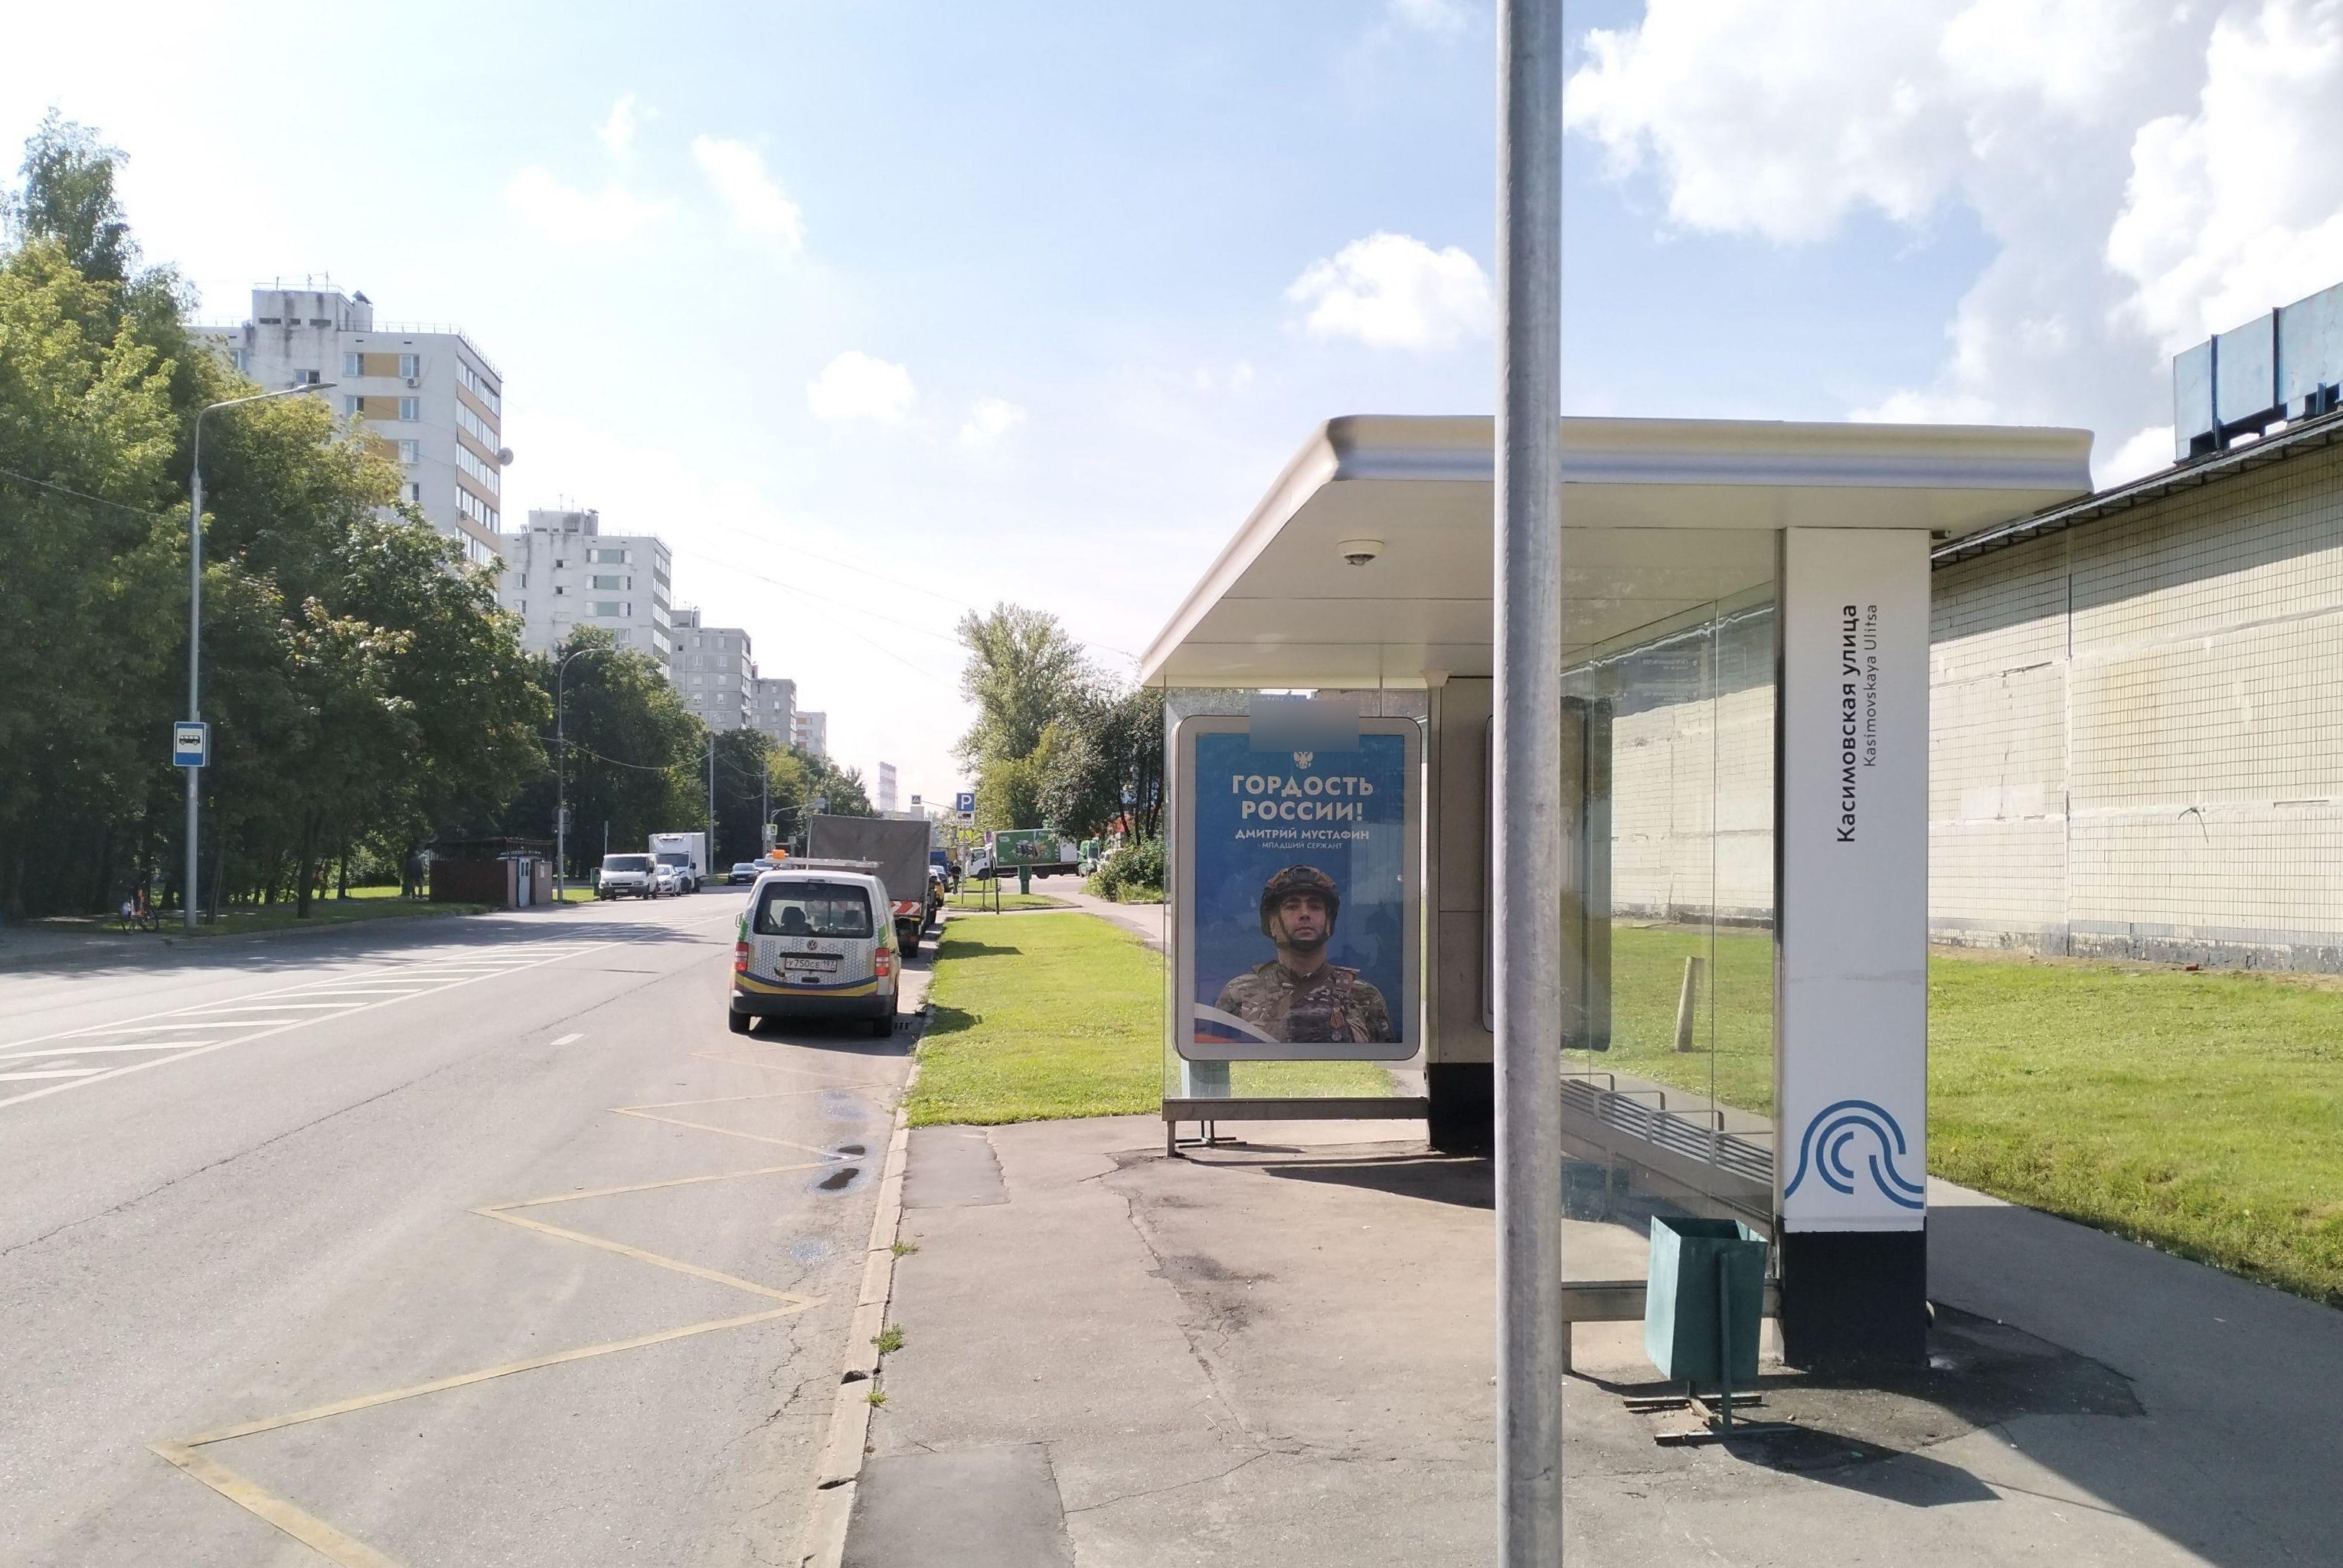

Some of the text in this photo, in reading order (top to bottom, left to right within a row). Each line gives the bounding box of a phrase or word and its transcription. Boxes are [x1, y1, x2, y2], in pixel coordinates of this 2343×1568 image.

[1864, 604, 1880, 766] Kasimovskaya Ulitsa
[1837, 604, 1861, 841] Касимовская улица
[1232, 775, 1374, 797] ГОРДОСТЬ
[1241, 800, 1363, 821] РОССИИ!
[1235, 827, 1369, 840] ДМИТРИЙ МУСТАФИН
[1307, 841, 1342, 850] СЕРЖАНТ
